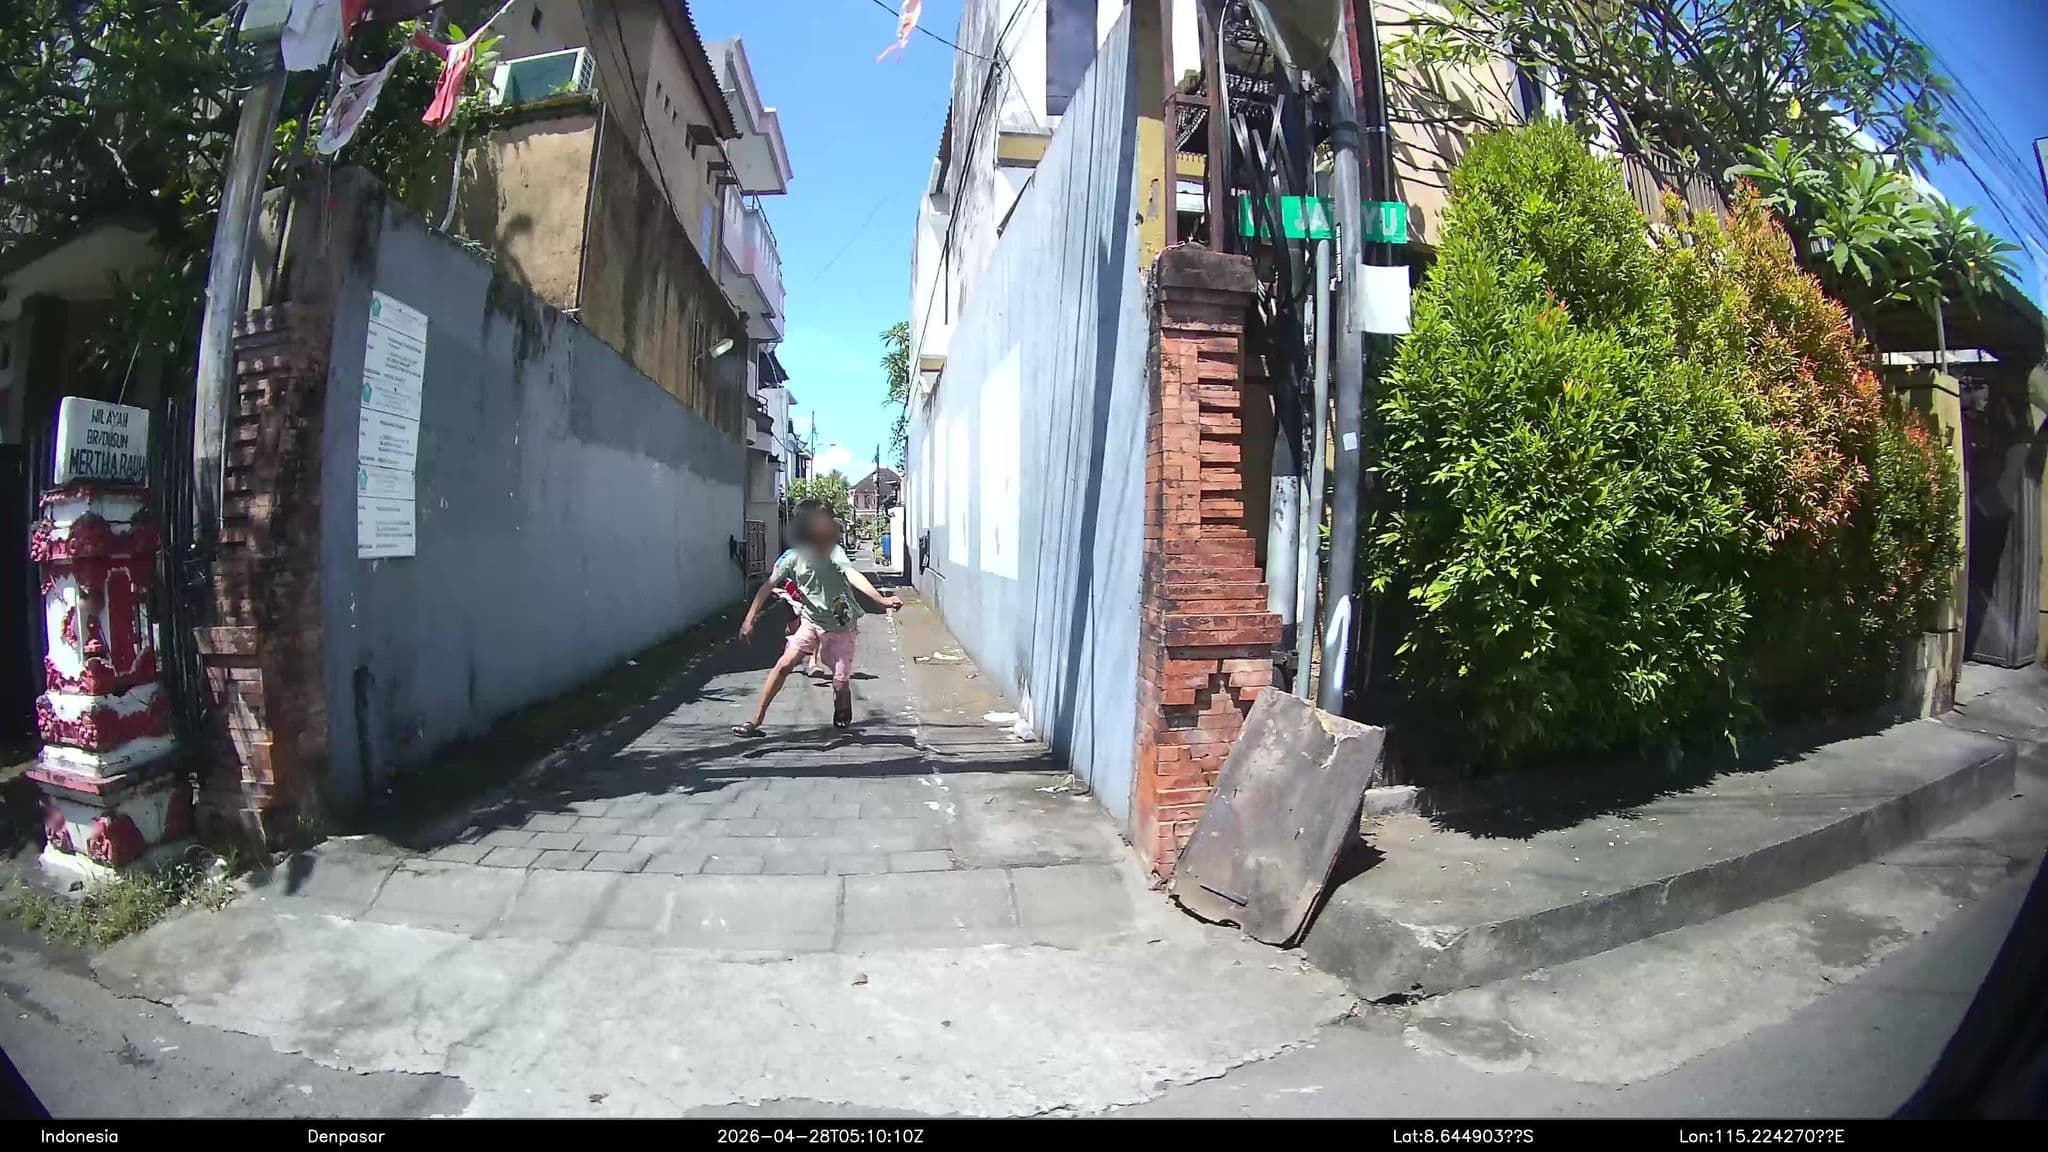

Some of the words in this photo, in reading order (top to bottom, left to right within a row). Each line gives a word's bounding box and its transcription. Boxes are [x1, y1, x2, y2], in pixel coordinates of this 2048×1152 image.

[91, 407, 128, 428] WILAYAH
[86, 429, 129, 449] BR/DUSUN
[69, 448, 118, 475] MERTHA
